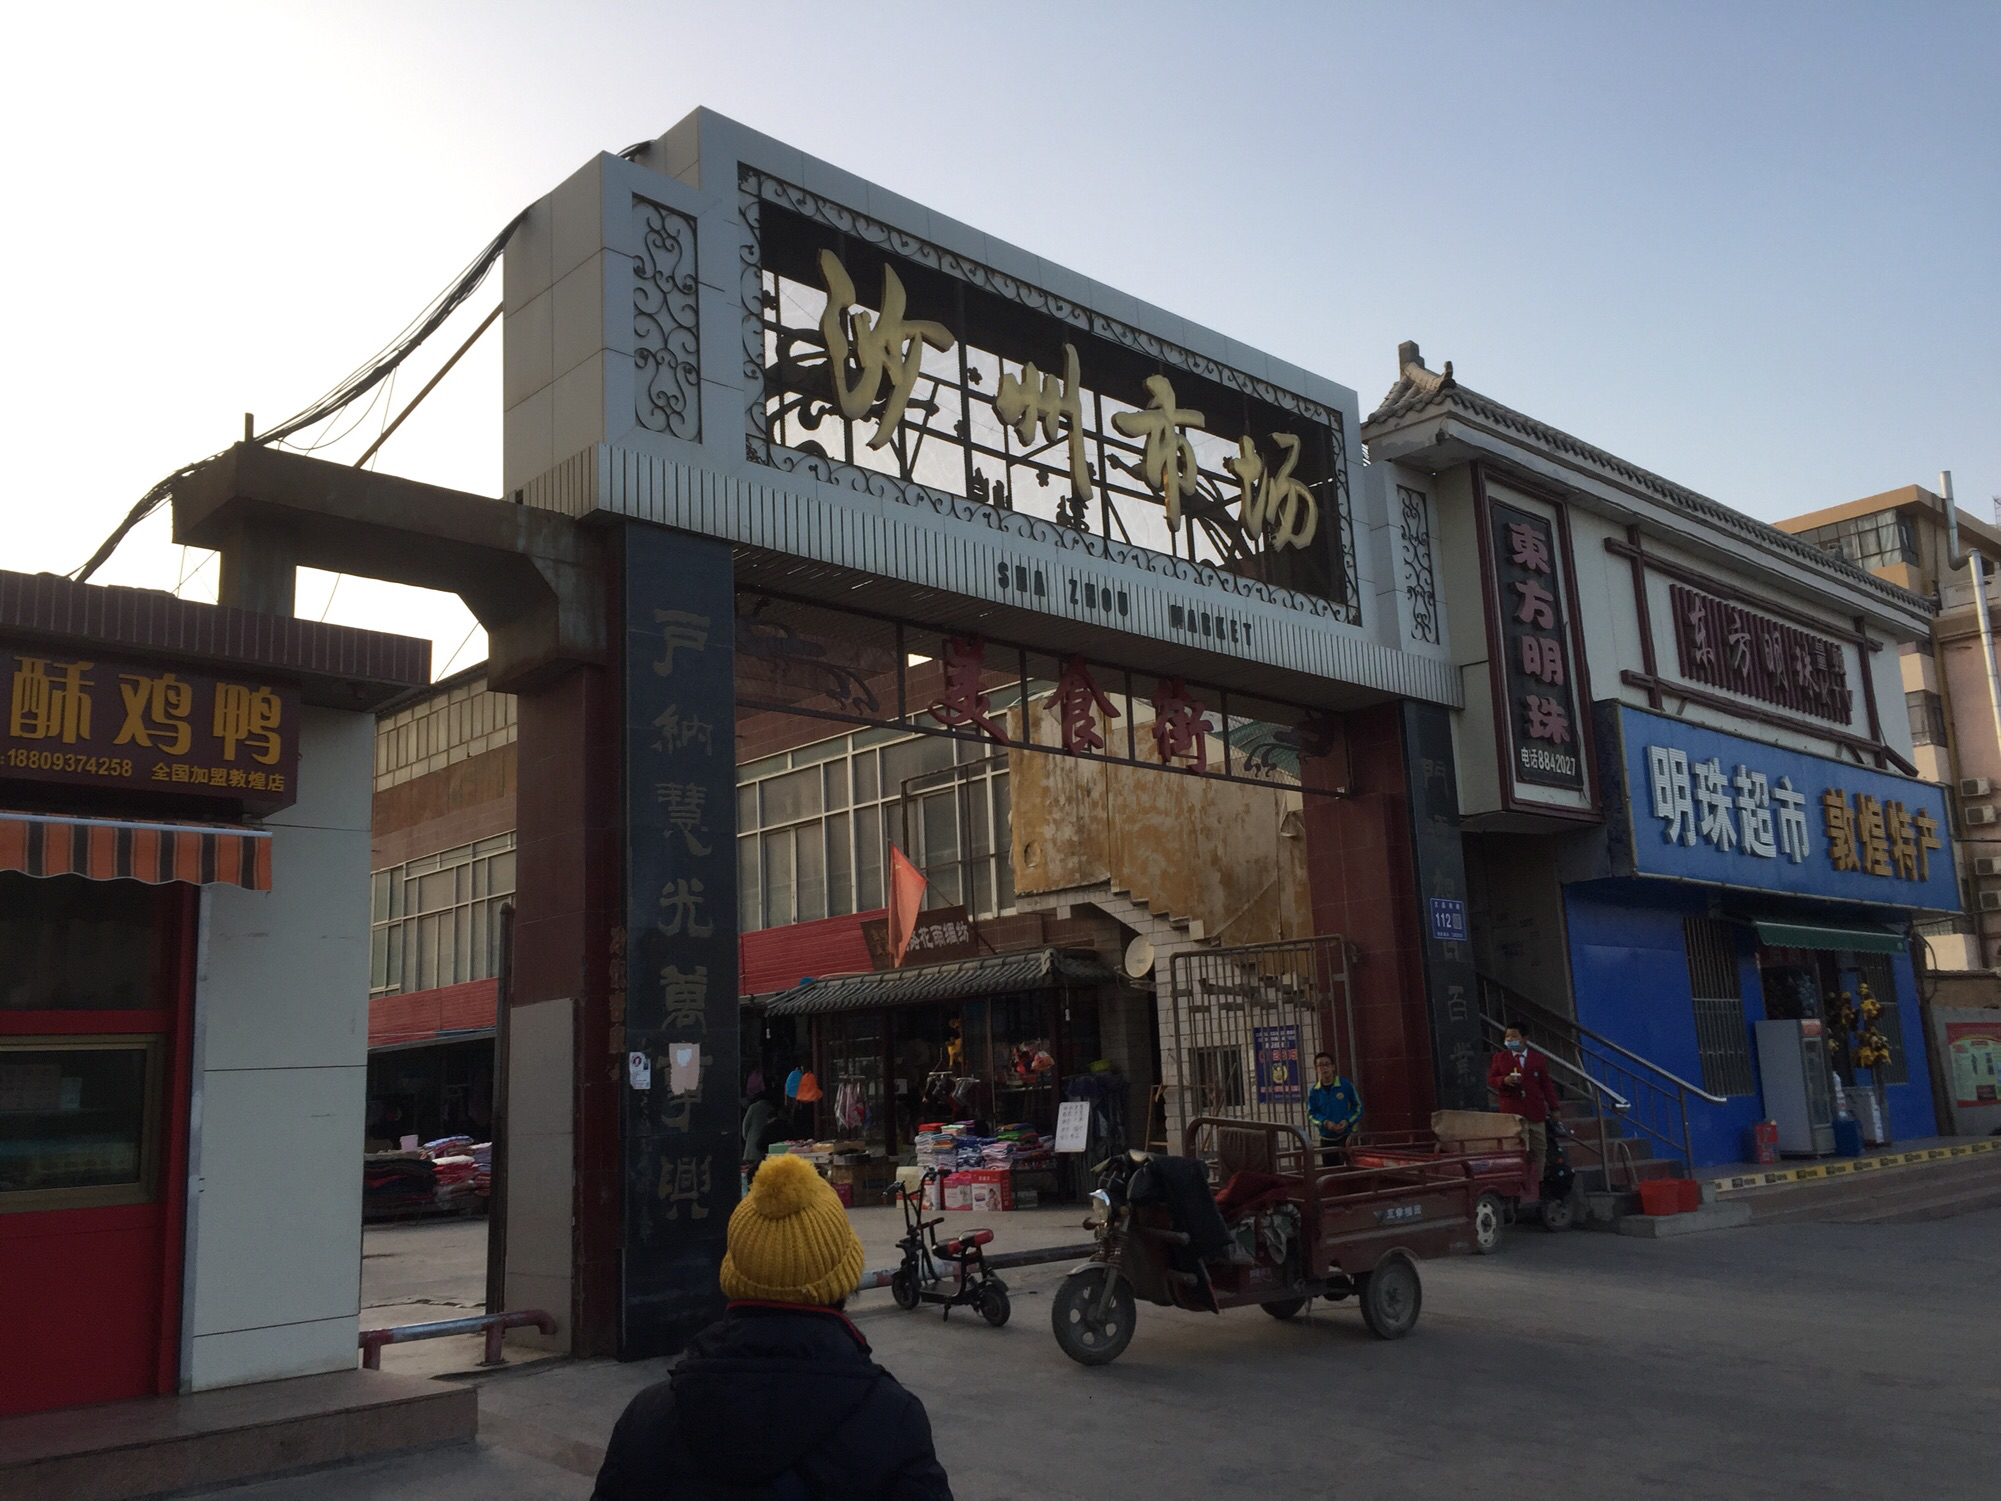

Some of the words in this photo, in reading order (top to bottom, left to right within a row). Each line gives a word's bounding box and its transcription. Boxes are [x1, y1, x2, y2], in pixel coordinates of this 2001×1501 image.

[816, 247, 1318, 554] 沙州市场
[997, 560, 1047, 598] SHA
[1068, 576, 1129, 618] ZHOU
[1169, 603, 1253, 647] MARKET
[8, 655, 283, 766] 酥鸡鸭
[927, 631, 1214, 775] 美食街
[151, 761, 285, 792] 全国加盟敦煌店
[1645, 744, 1811, 864] 明珠超市
[1822, 787, 1943, 882] 敦煌特产
[1435, 912, 1452, 928] 112
